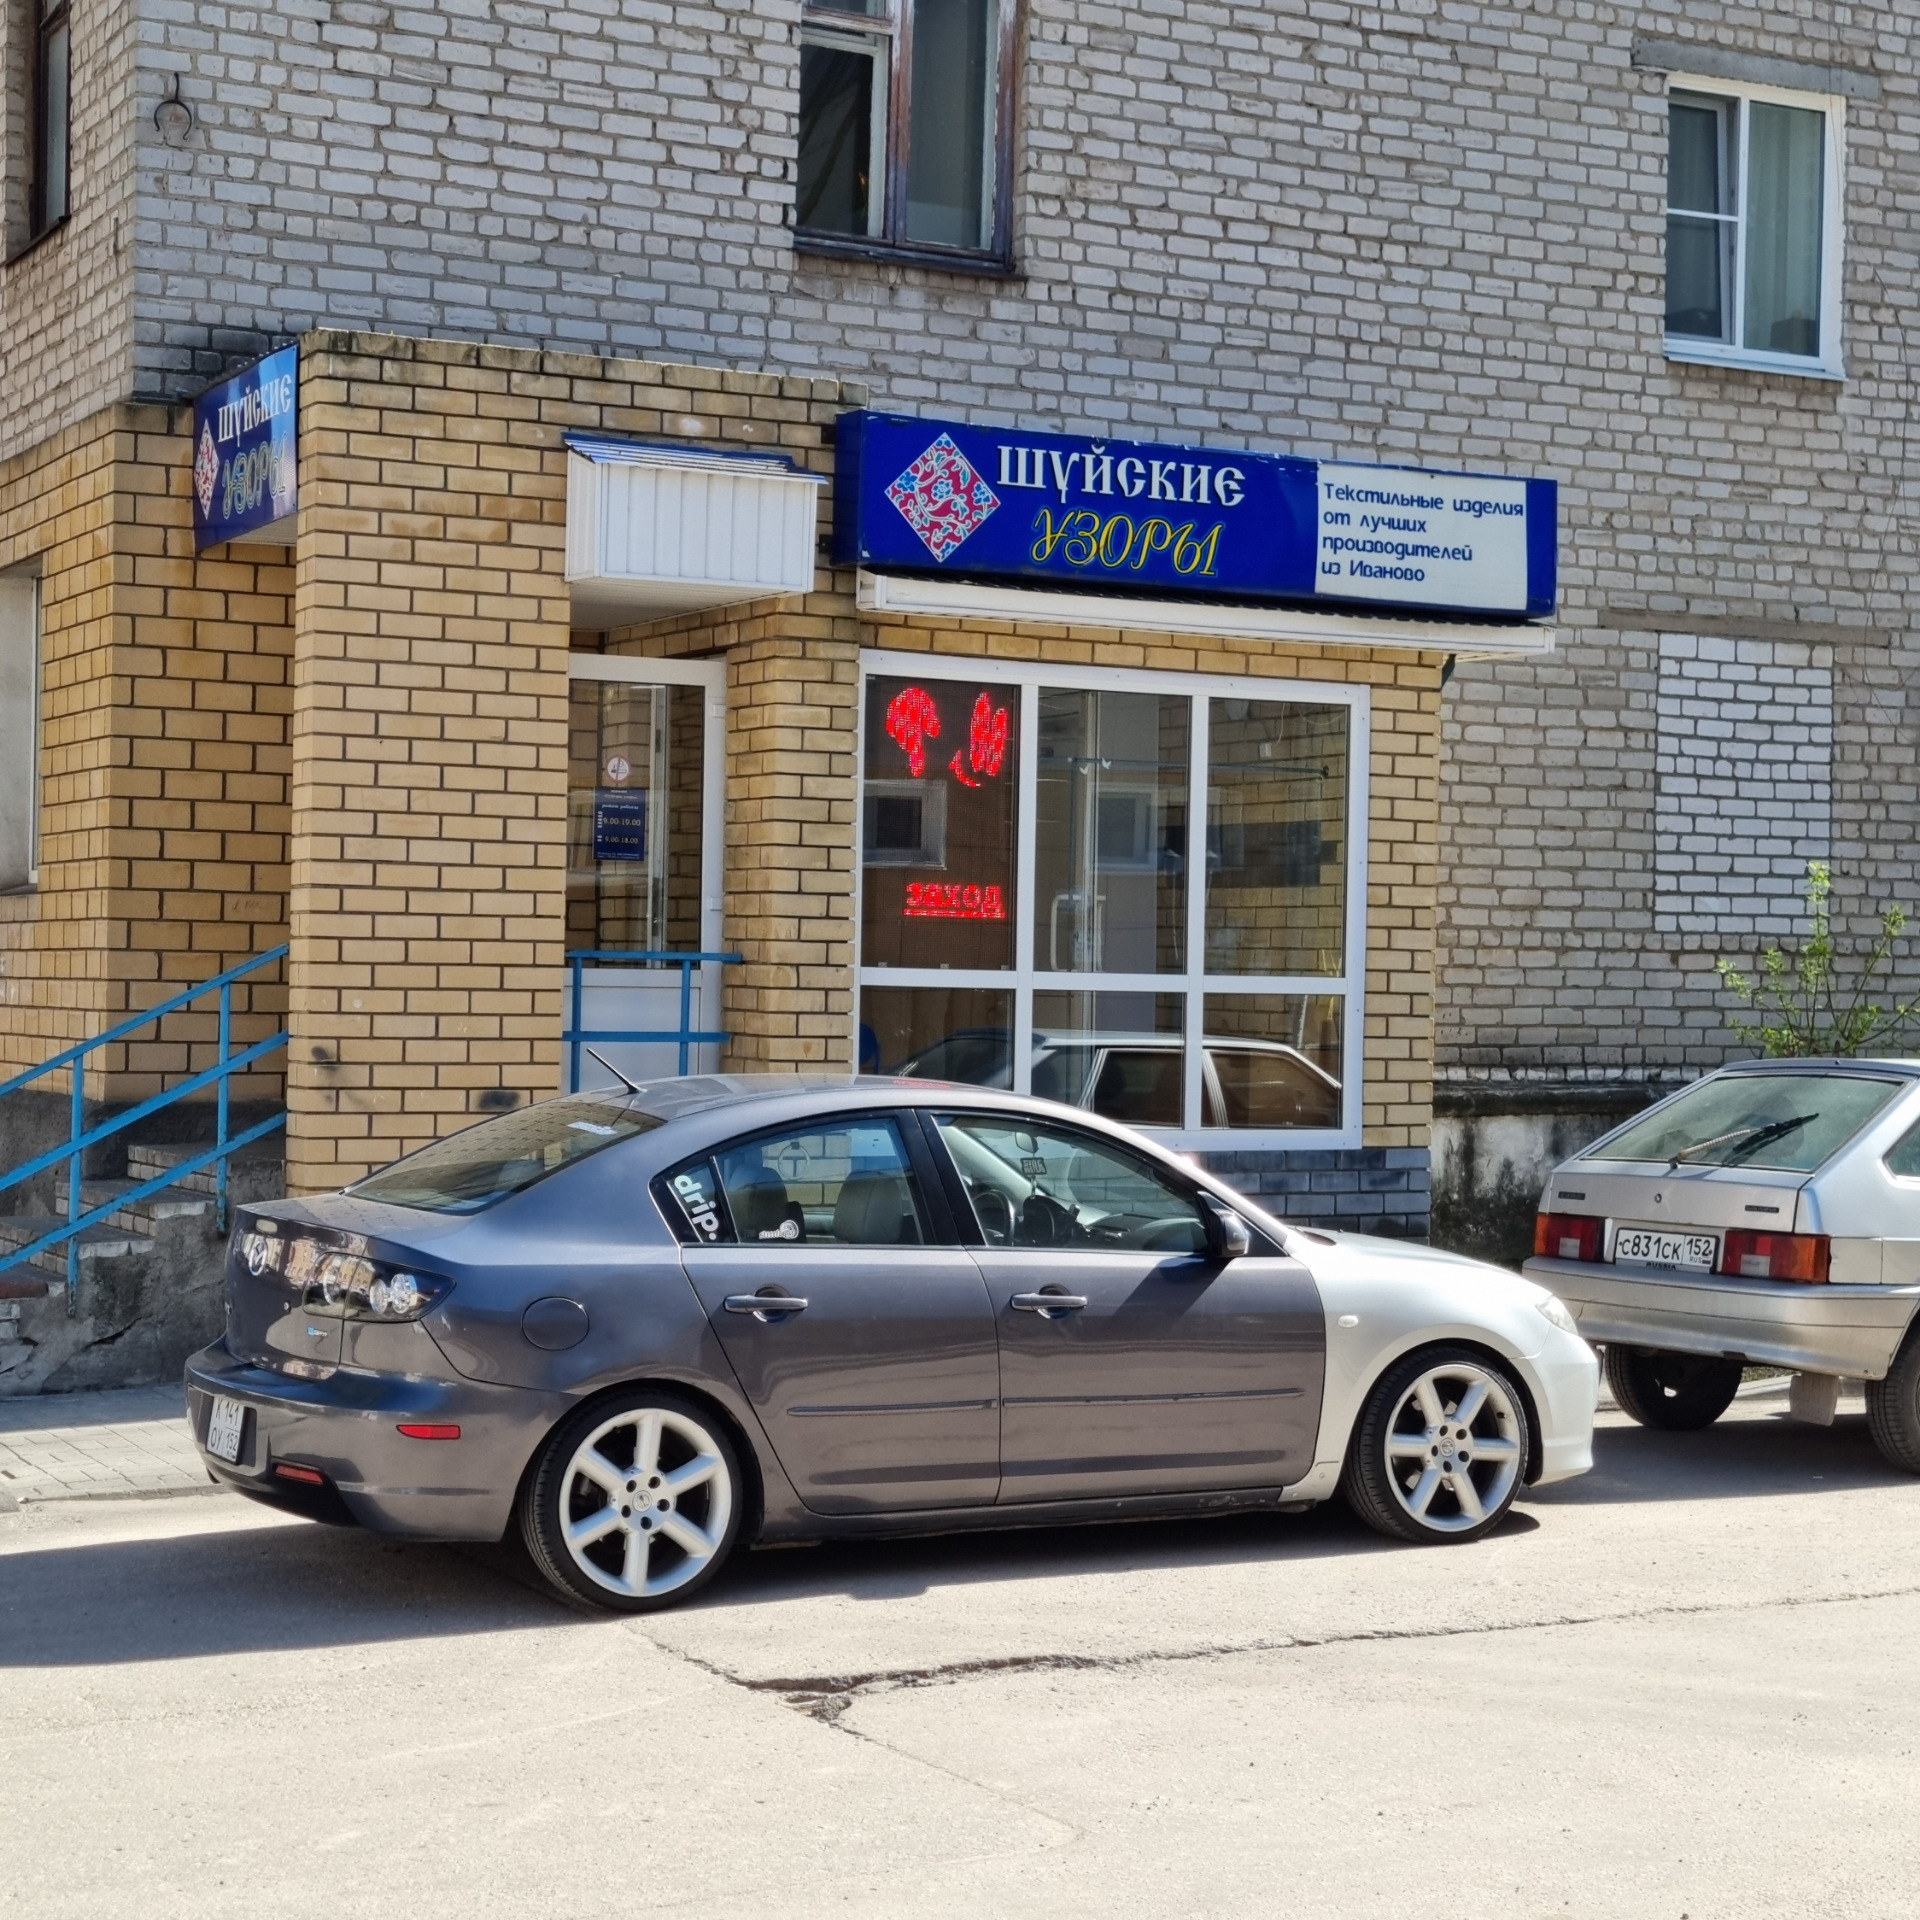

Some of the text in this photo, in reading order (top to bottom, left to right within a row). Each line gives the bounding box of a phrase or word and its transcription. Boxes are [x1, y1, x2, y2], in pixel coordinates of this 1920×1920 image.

[217, 374, 292, 448] ШУЙСКИЕ
[996, 444, 1246, 507] ШУЙСКИЕ
[1323, 482, 1524, 518] Текстильные изделия
[1323, 511, 1427, 533] от лучших
[1031, 507, 1223, 576] УЗОРЫ
[1322, 536, 1473, 562] производителей
[1321, 560, 1425, 582] из Иваново
[674, 1174, 720, 1240] drip.
[1686, 1237, 1711, 1257] 152
